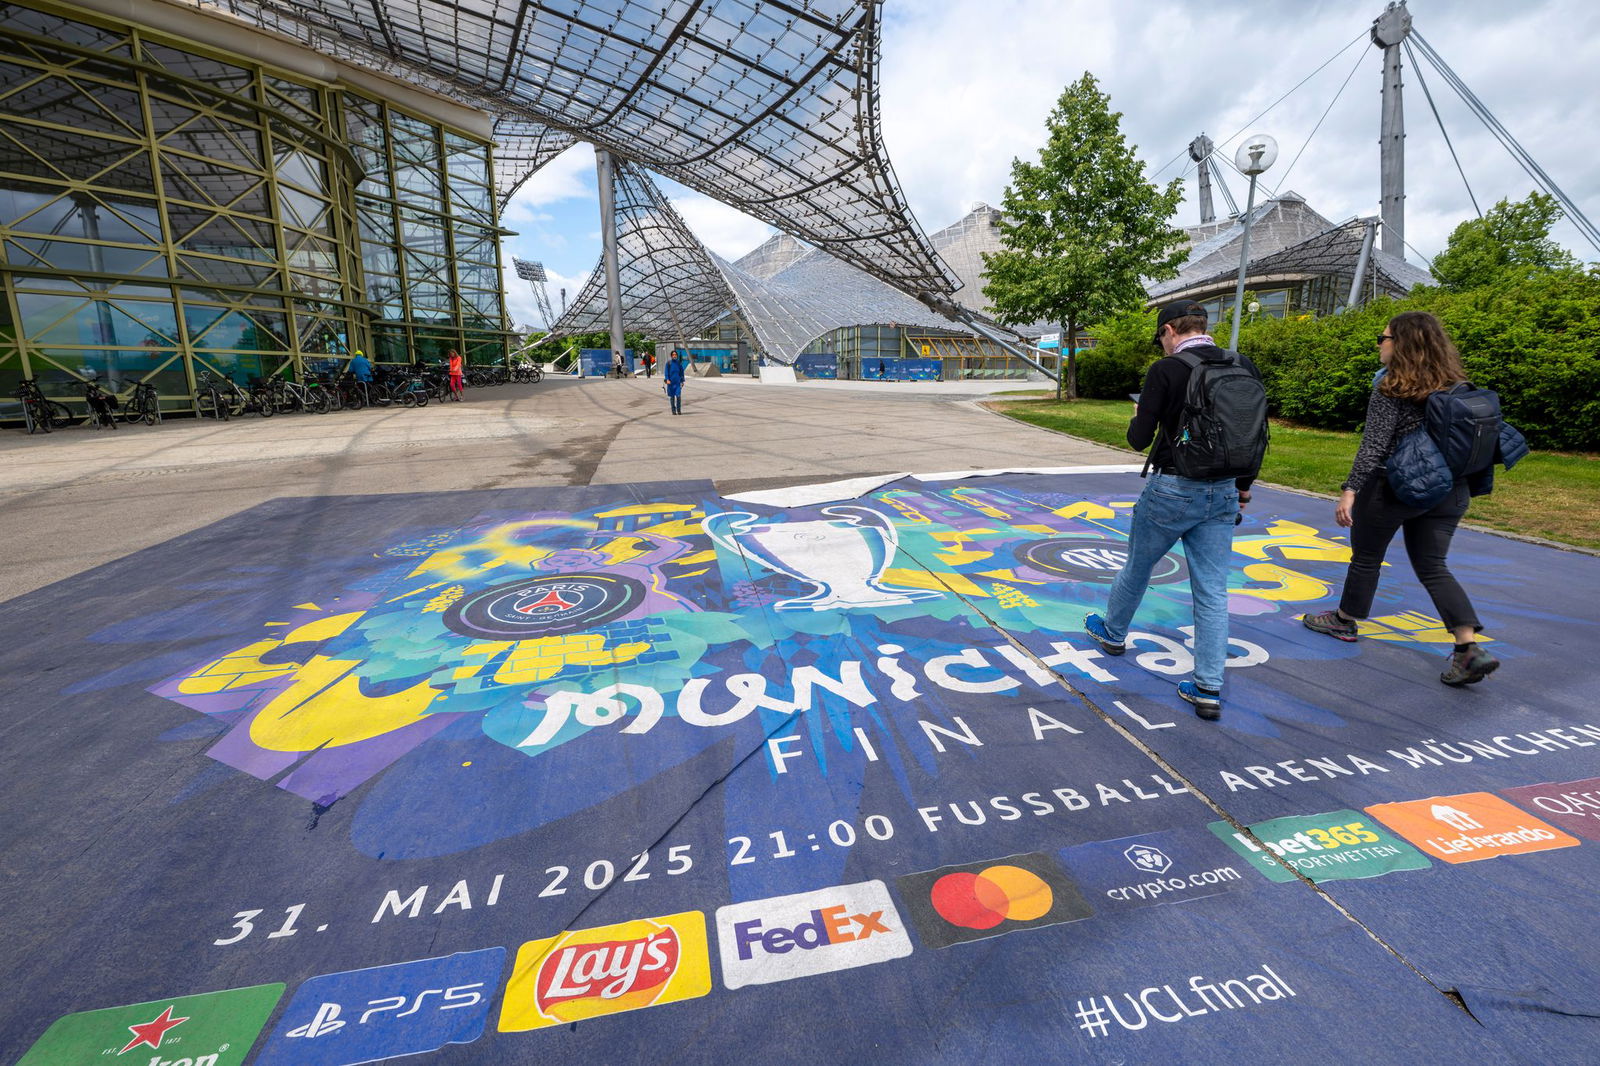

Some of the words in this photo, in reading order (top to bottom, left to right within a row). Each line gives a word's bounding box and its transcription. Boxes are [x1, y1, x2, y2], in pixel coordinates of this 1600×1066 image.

[517, 584, 590, 597] PARIS
[769, 700, 1177, 774] FINAL
[213, 903, 329, 946] 31.
[371, 874, 504, 924] MAI
[538, 844, 693, 898] 2025
[728, 814, 894, 866] 21:00
[918, 774, 1190, 832] FUSSBALL
[1219, 754, 1390, 793] ARENA
[1232, 822, 1380, 857] bet365
[1425, 825, 1557, 855] Lieferando
[1107, 863, 1242, 902] crypto.com
[734, 904, 893, 961] FedEx
[544, 933, 672, 999] Lay's
[359, 982, 485, 1024] PS5
[1075, 964, 1297, 1038] #UCLfinal
